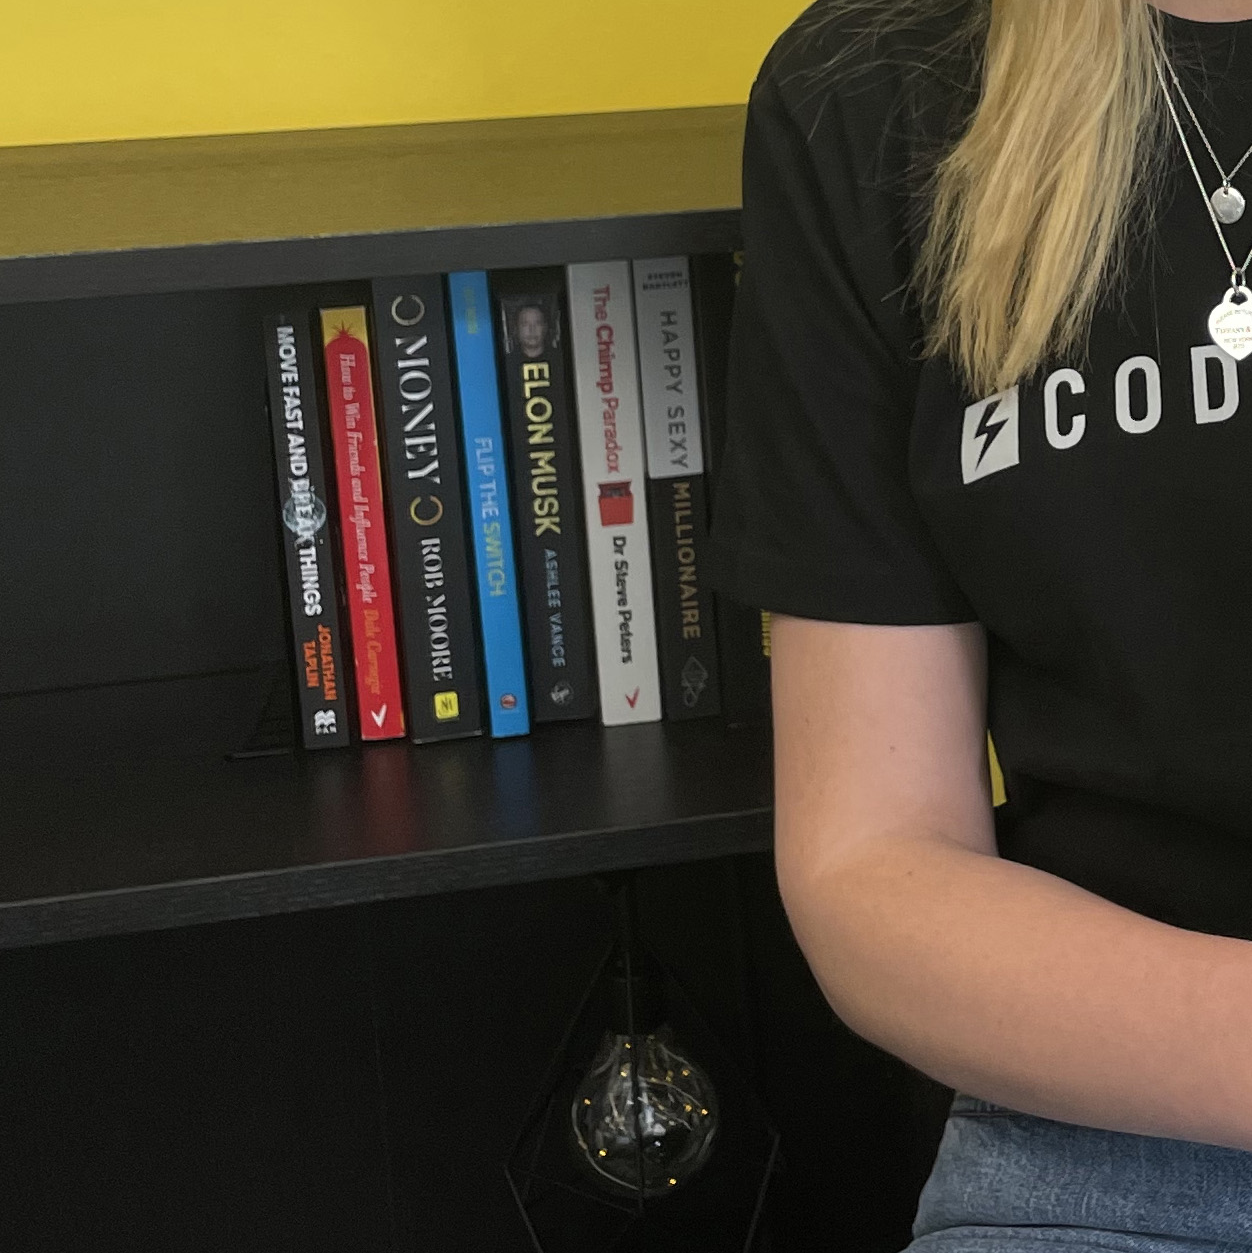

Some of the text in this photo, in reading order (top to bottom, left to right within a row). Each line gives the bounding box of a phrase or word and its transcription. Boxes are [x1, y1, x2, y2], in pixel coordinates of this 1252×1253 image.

[276, 325, 298, 383] MOVE
[282, 386, 304, 430] FAST
[395, 335, 441, 484] MONEY
[593, 284, 623, 474] The Chimp Paradox
[659, 310, 689, 469] HAPPY SEXY
[287, 433, 308, 476] AND
[339, 353, 378, 604] How to Win Friends and Influence People
[522, 361, 562, 537] ELON MUSK
[420, 537, 444, 588] ROB
[474, 437, 506, 597] FLIP THE SWITCH
[672, 481, 702, 640] MILLIONAIRE
[298, 546, 323, 617] THINGS
[425, 594, 453, 681] MOORE
[544, 548, 567, 668] ASHLEE VANCE
[613, 535, 634, 665] Dr Steve Peters
[303, 640, 320, 687] TAPLIN
[317, 623, 338, 700] JONATHAN
